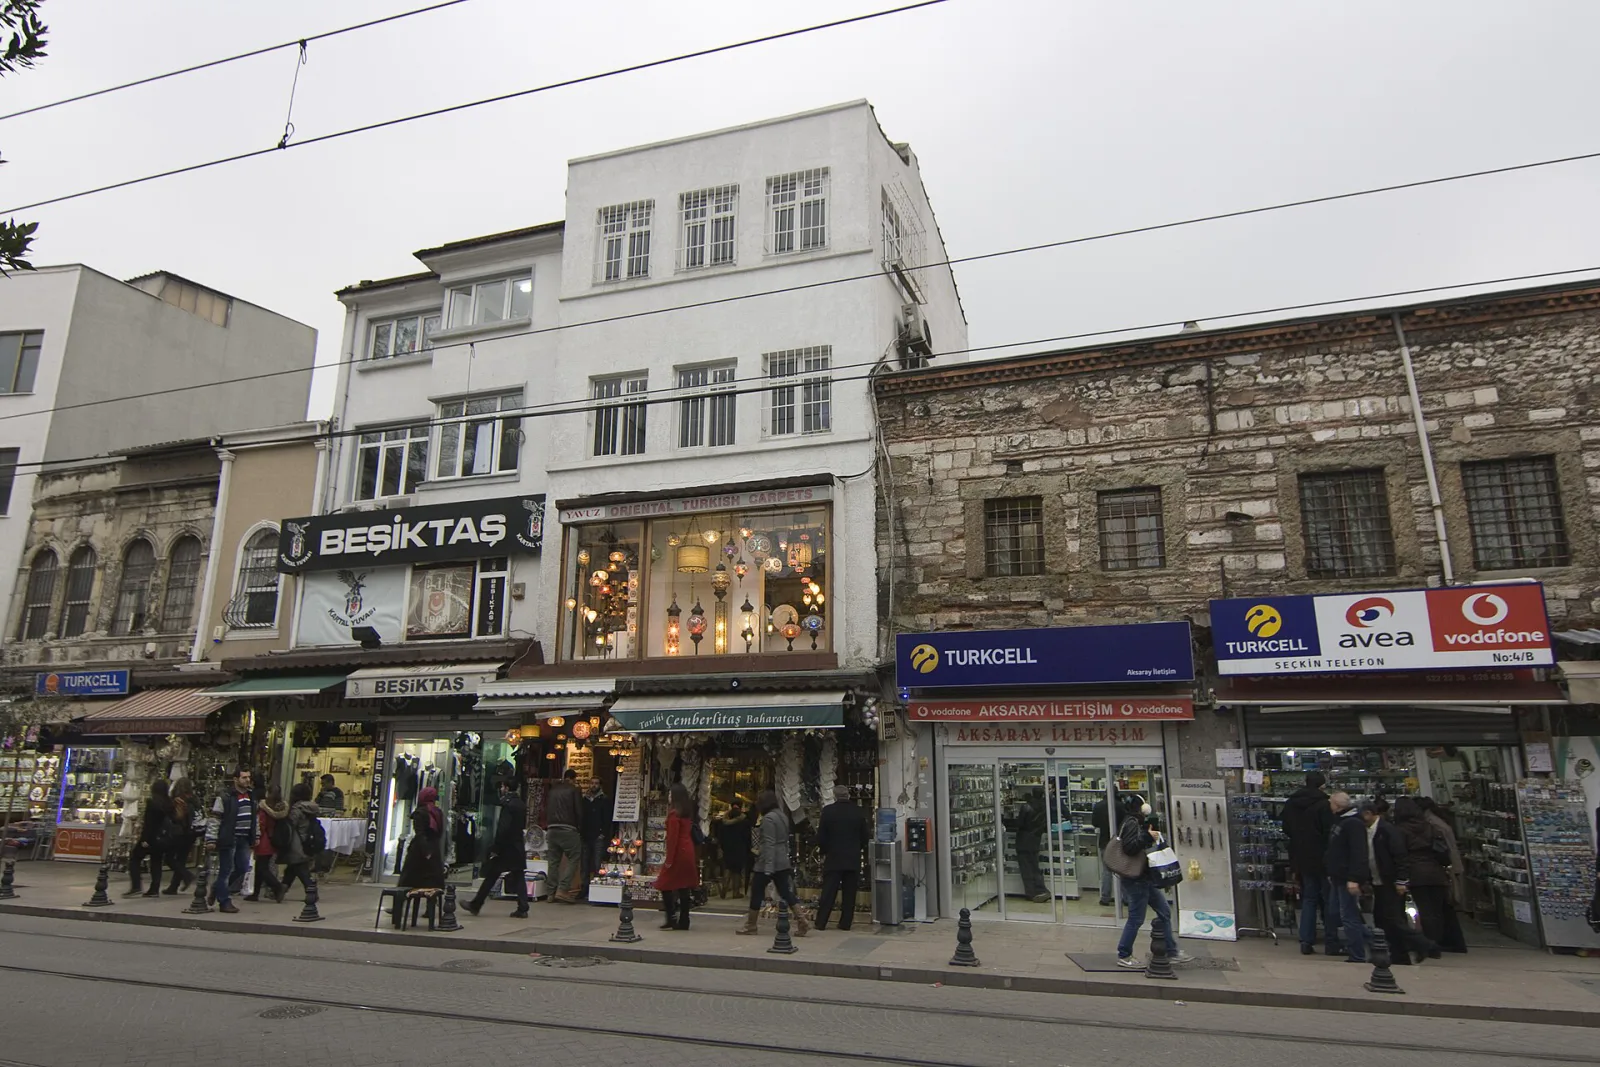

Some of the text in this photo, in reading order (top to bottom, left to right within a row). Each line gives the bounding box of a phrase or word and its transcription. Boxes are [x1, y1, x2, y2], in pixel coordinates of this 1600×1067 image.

[611, 488, 813, 517] ORIENTAL TURKISH CARPETS
[566, 509, 600, 519] YAVUZ
[319, 514, 507, 557] BEŞİKTAŞ
[328, 607, 376, 627] KARTAL YUVASI
[1338, 631, 1415, 649] avea
[1444, 628, 1545, 645] vodafone
[1225, 638, 1309, 655] TURKCELL
[944, 647, 1038, 666] TURKCELL
[1274, 657, 1385, 670] SEÇKİN TELEFON
[1492, 652, 1535, 663] No:4/B
[1126, 667, 1177, 677] Aksaray İletişim
[64, 674, 120, 688] TURKCELL
[930, 702, 1184, 719] vodafone AKSARAY İLETİŞİM vodafone
[638, 711, 804, 730] Tarihi Çemberlitaş Baharatçısı
[956, 724, 1146, 745] AKSARAY İLETİŞİM
[71, 831, 103, 841] TURKCELL
